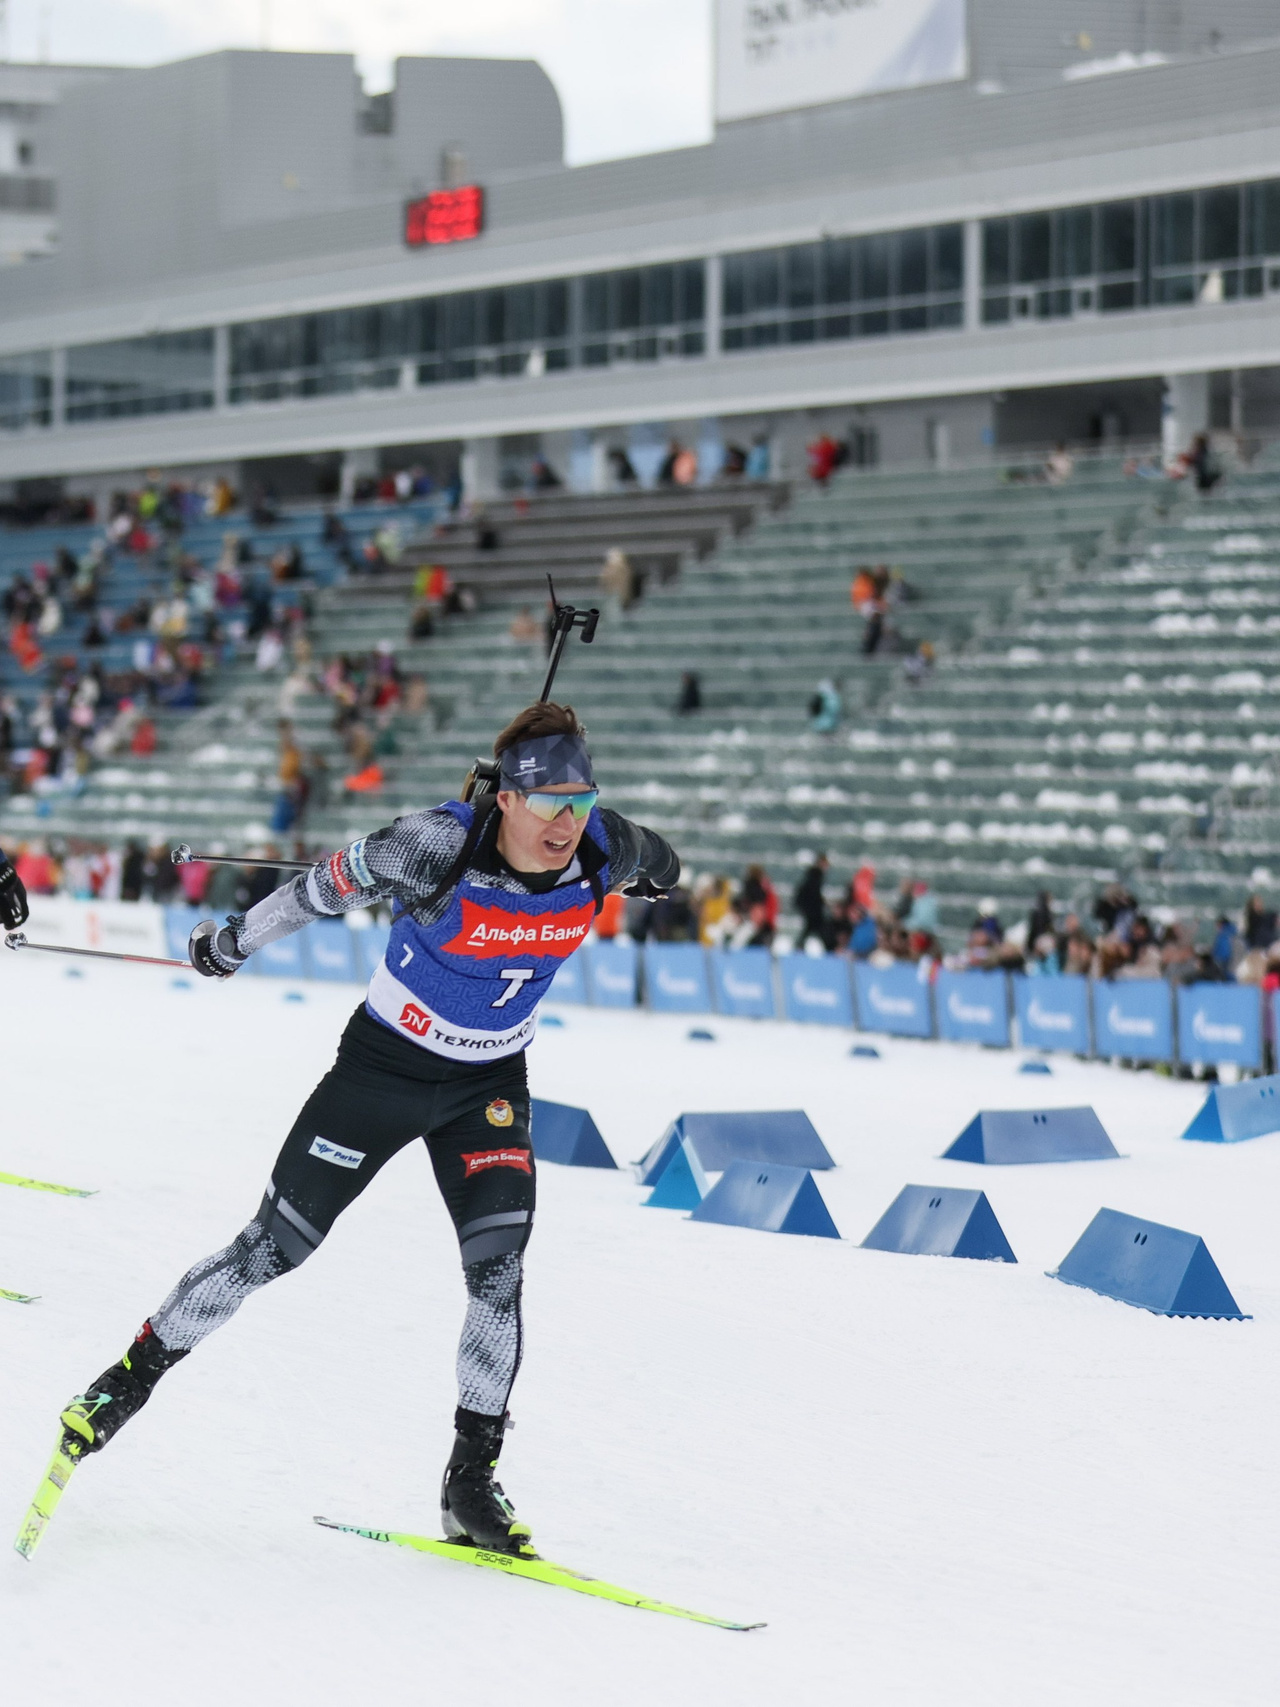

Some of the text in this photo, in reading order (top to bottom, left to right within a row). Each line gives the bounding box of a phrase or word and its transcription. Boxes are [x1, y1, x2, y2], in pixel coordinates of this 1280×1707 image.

[467, 923, 588, 946] Альфа Банк
[399, 943, 414, 968] 7
[490, 969, 535, 1008] 7
[333, 1151, 361, 1163] Parker
[470, 1155, 499, 1170] Альфа
[475, 1551, 513, 1567] FISCHER
